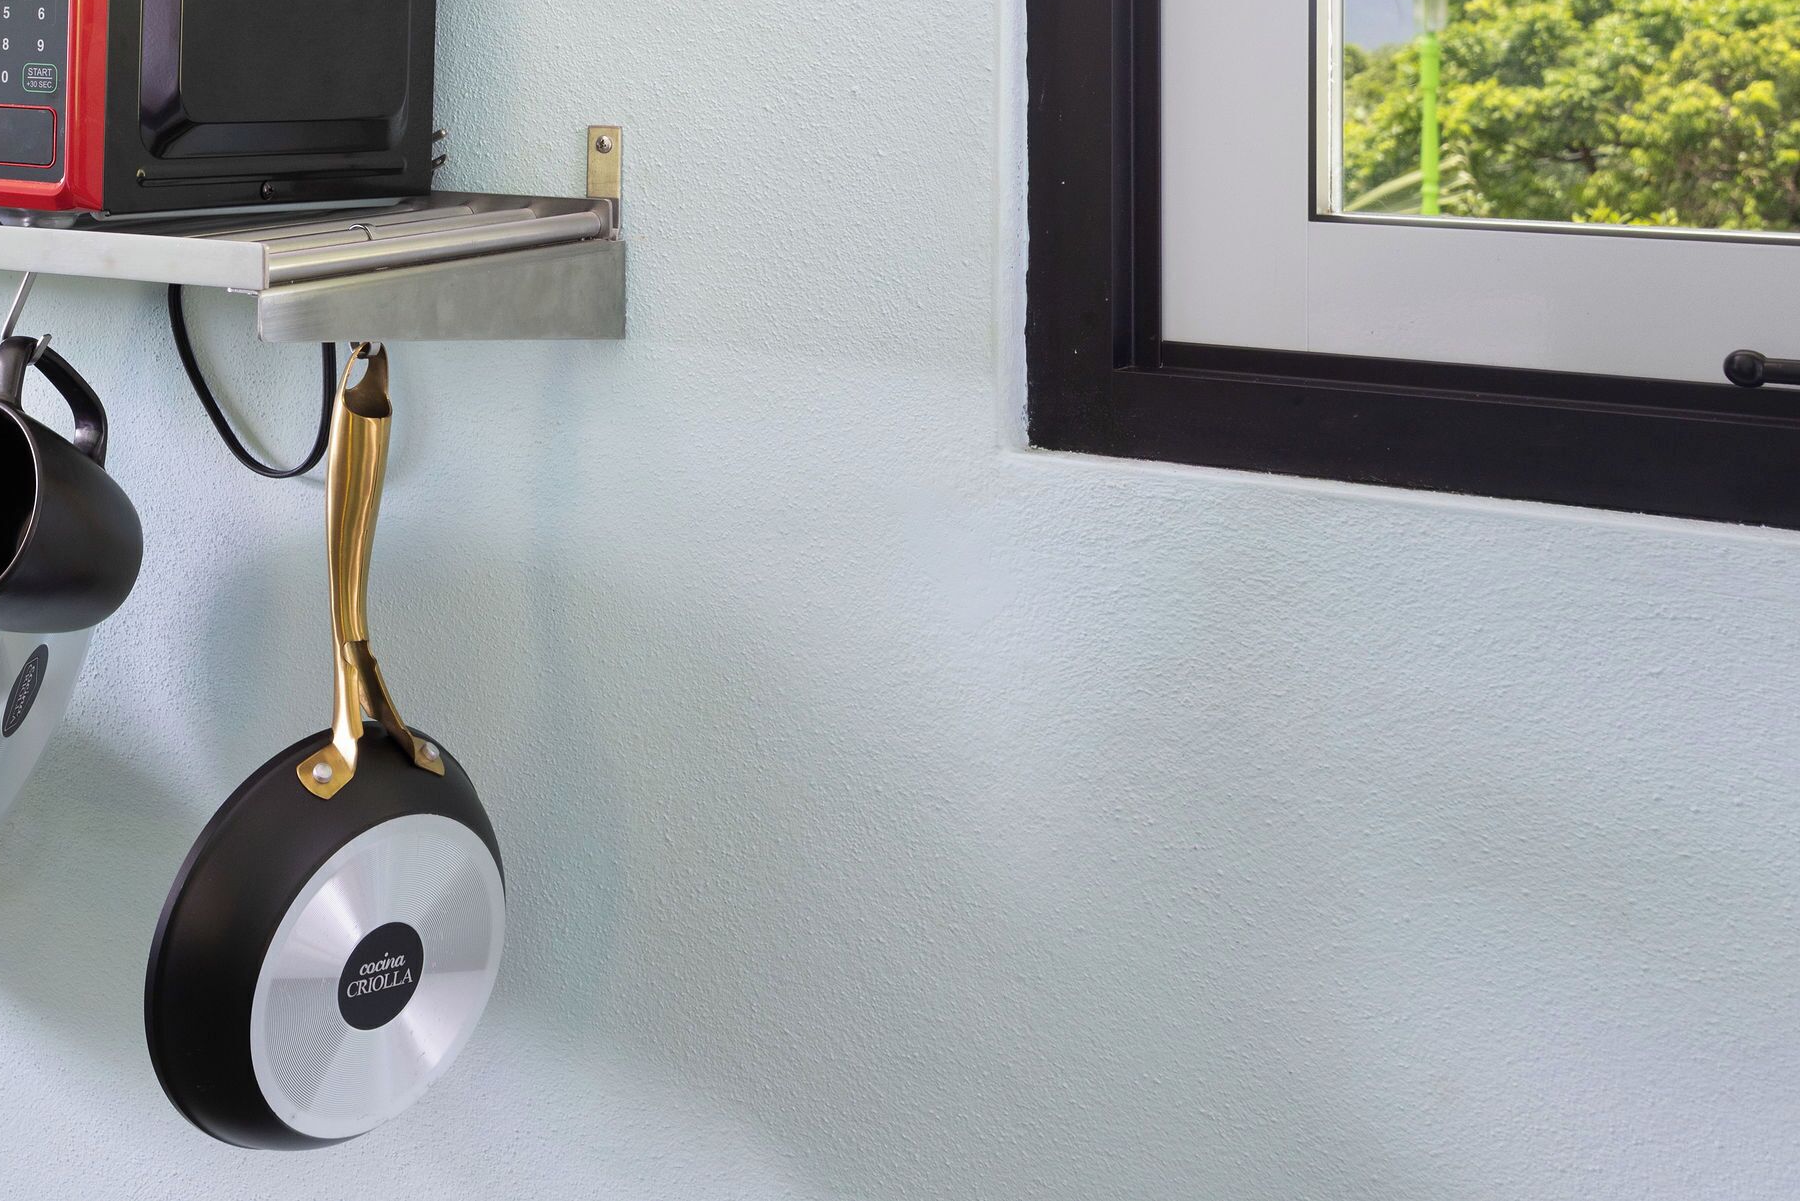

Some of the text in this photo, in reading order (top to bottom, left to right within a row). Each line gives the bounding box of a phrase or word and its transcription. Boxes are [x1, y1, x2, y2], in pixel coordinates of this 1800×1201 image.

[3, 6, 10, 19] 5
[38, 7, 45, 20] 6
[2, 38, 9, 50] 8
[37, 39, 44, 51] 9
[1, 70, 8, 83] 0
[28, 68, 52, 76] START
[360, 952, 406, 976] cocina
[346, 968, 413, 998] CRIOLLA
